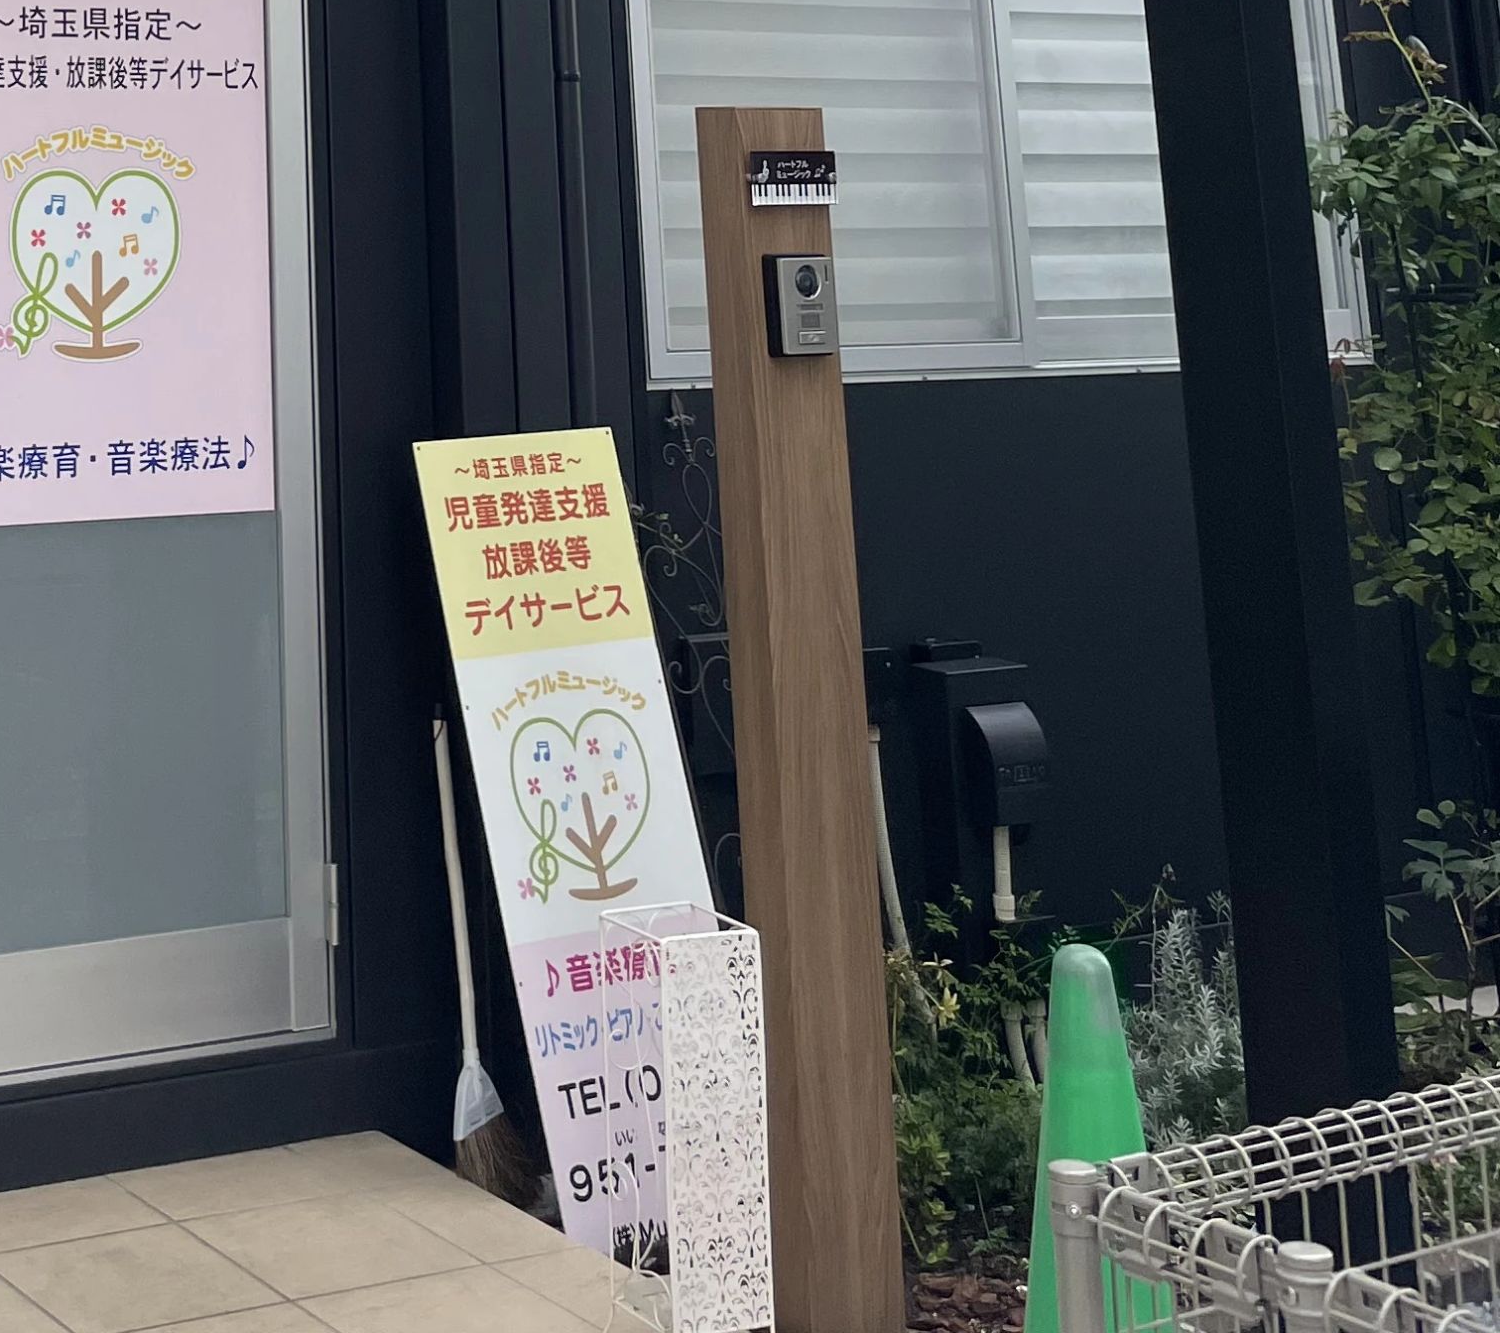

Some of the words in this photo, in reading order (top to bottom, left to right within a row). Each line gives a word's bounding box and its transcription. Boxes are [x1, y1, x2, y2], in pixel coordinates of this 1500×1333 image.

[1, 126, 198, 181] ハートフルミュージック
[444, 482, 611, 532] 児童発達支援
[482, 535, 592, 580] 放課後等
[464, 584, 631, 636] デイサービス
[490, 670, 648, 731] ハートフルミュージック
